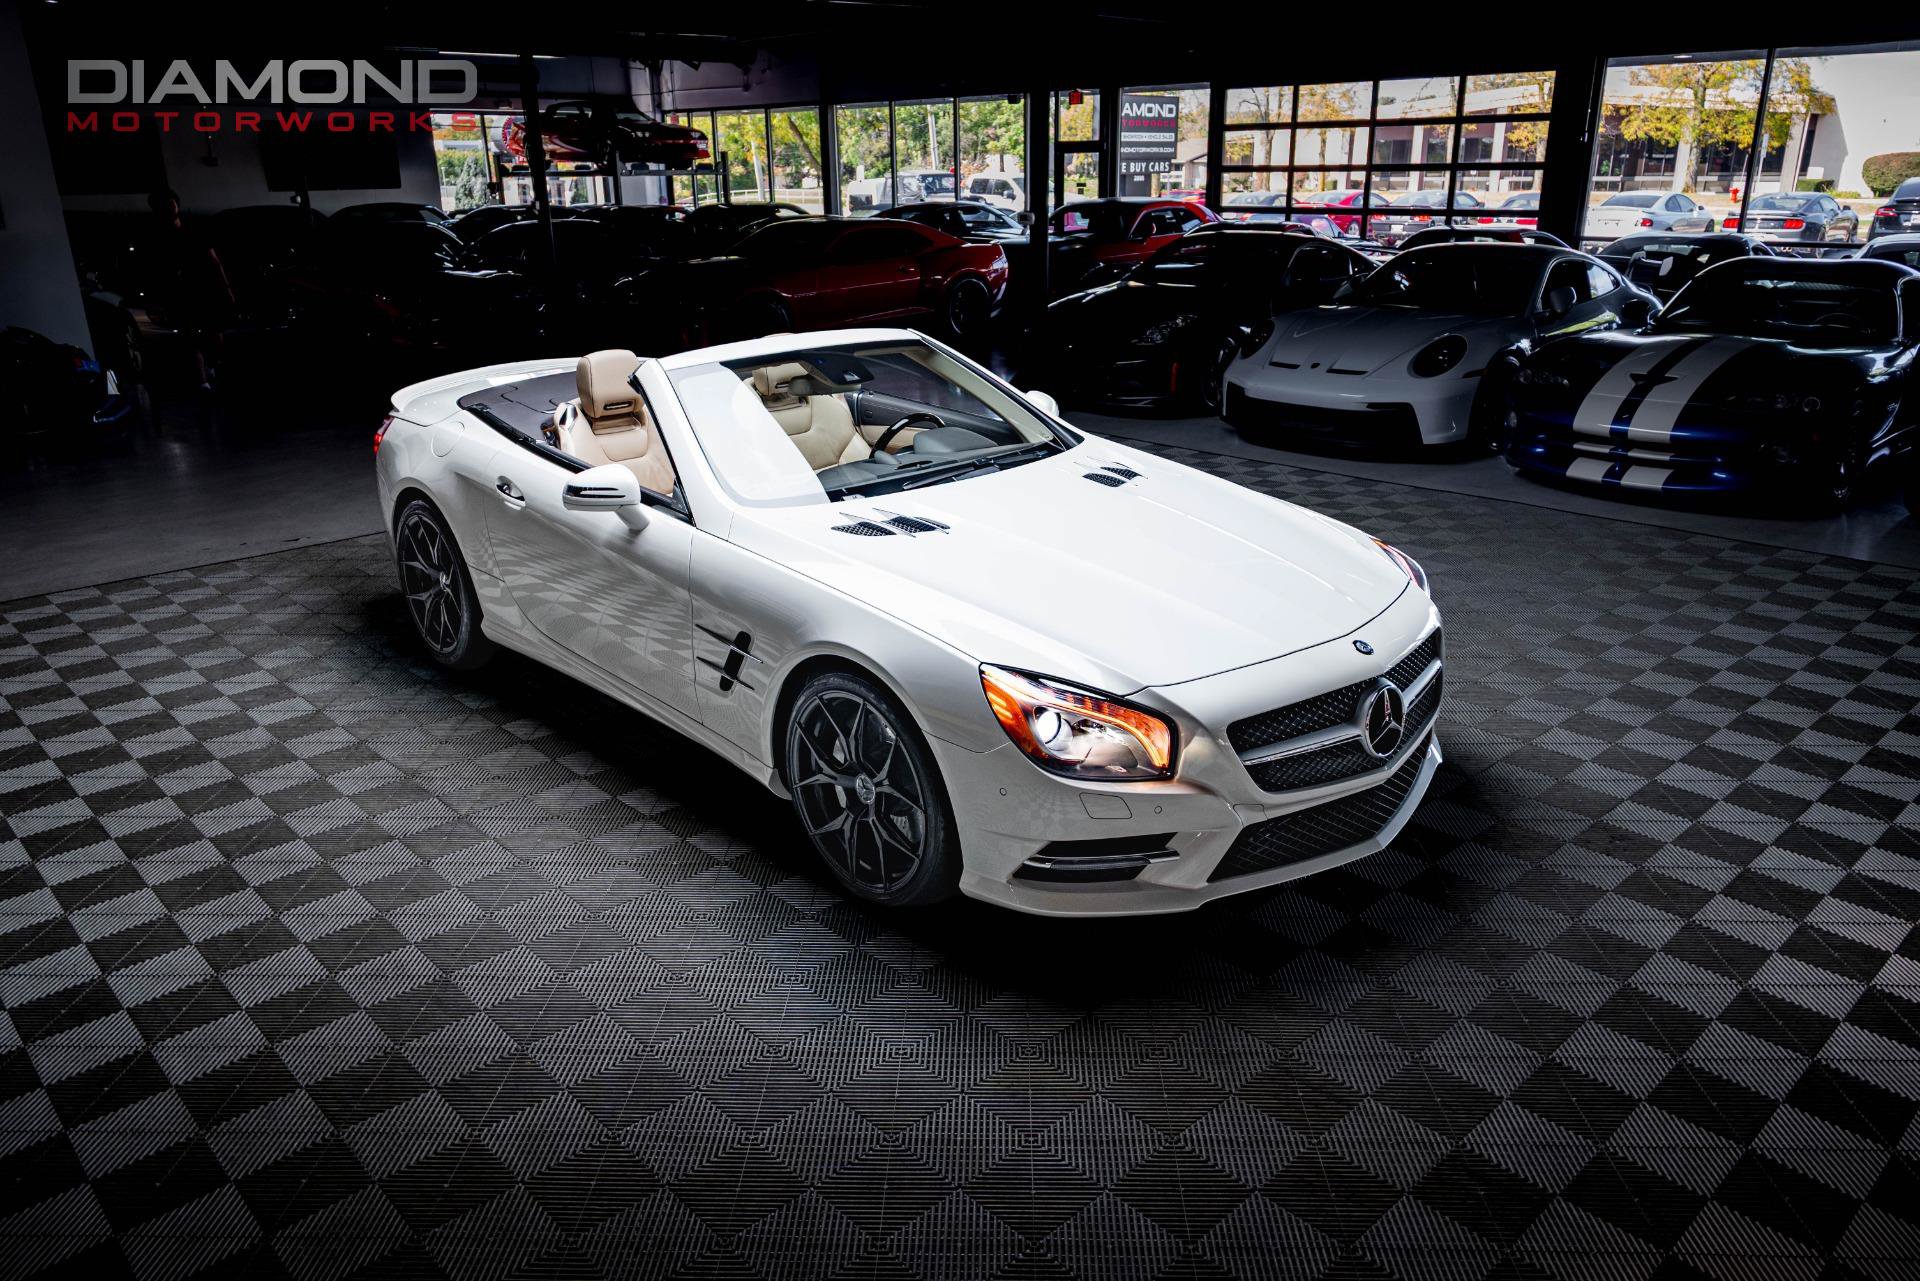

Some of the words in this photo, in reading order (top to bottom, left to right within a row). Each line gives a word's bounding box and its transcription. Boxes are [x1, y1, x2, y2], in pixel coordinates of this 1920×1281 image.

[1121, 102, 1176, 117] AMOND
[1130, 162, 1146, 173] BUY
[1148, 162, 1170, 172] CARS
